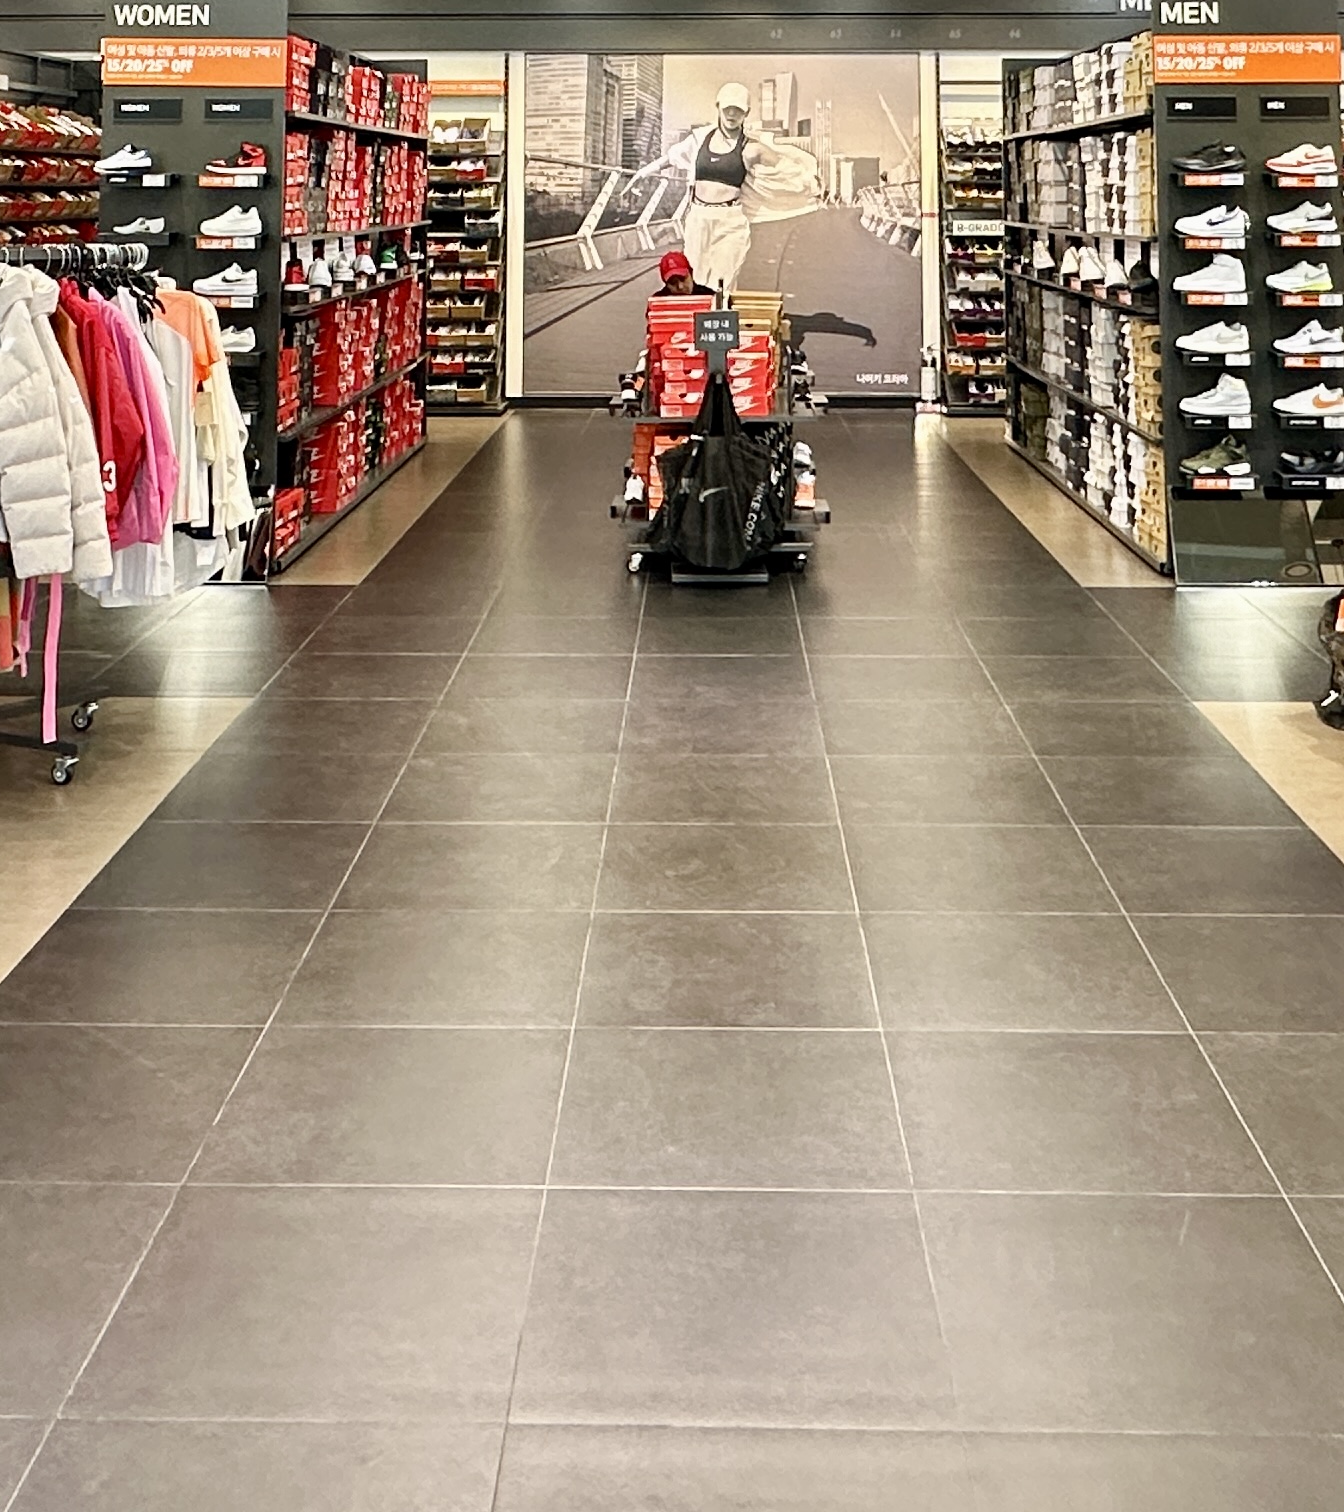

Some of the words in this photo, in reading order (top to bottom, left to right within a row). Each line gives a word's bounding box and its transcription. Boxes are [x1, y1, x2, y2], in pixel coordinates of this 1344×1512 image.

[113, 4, 210, 26] WOMEN
[1160, 1, 1220, 25] MEN
[170, 58, 194, 73] OFF
[1222, 56, 1246, 70] OFF
